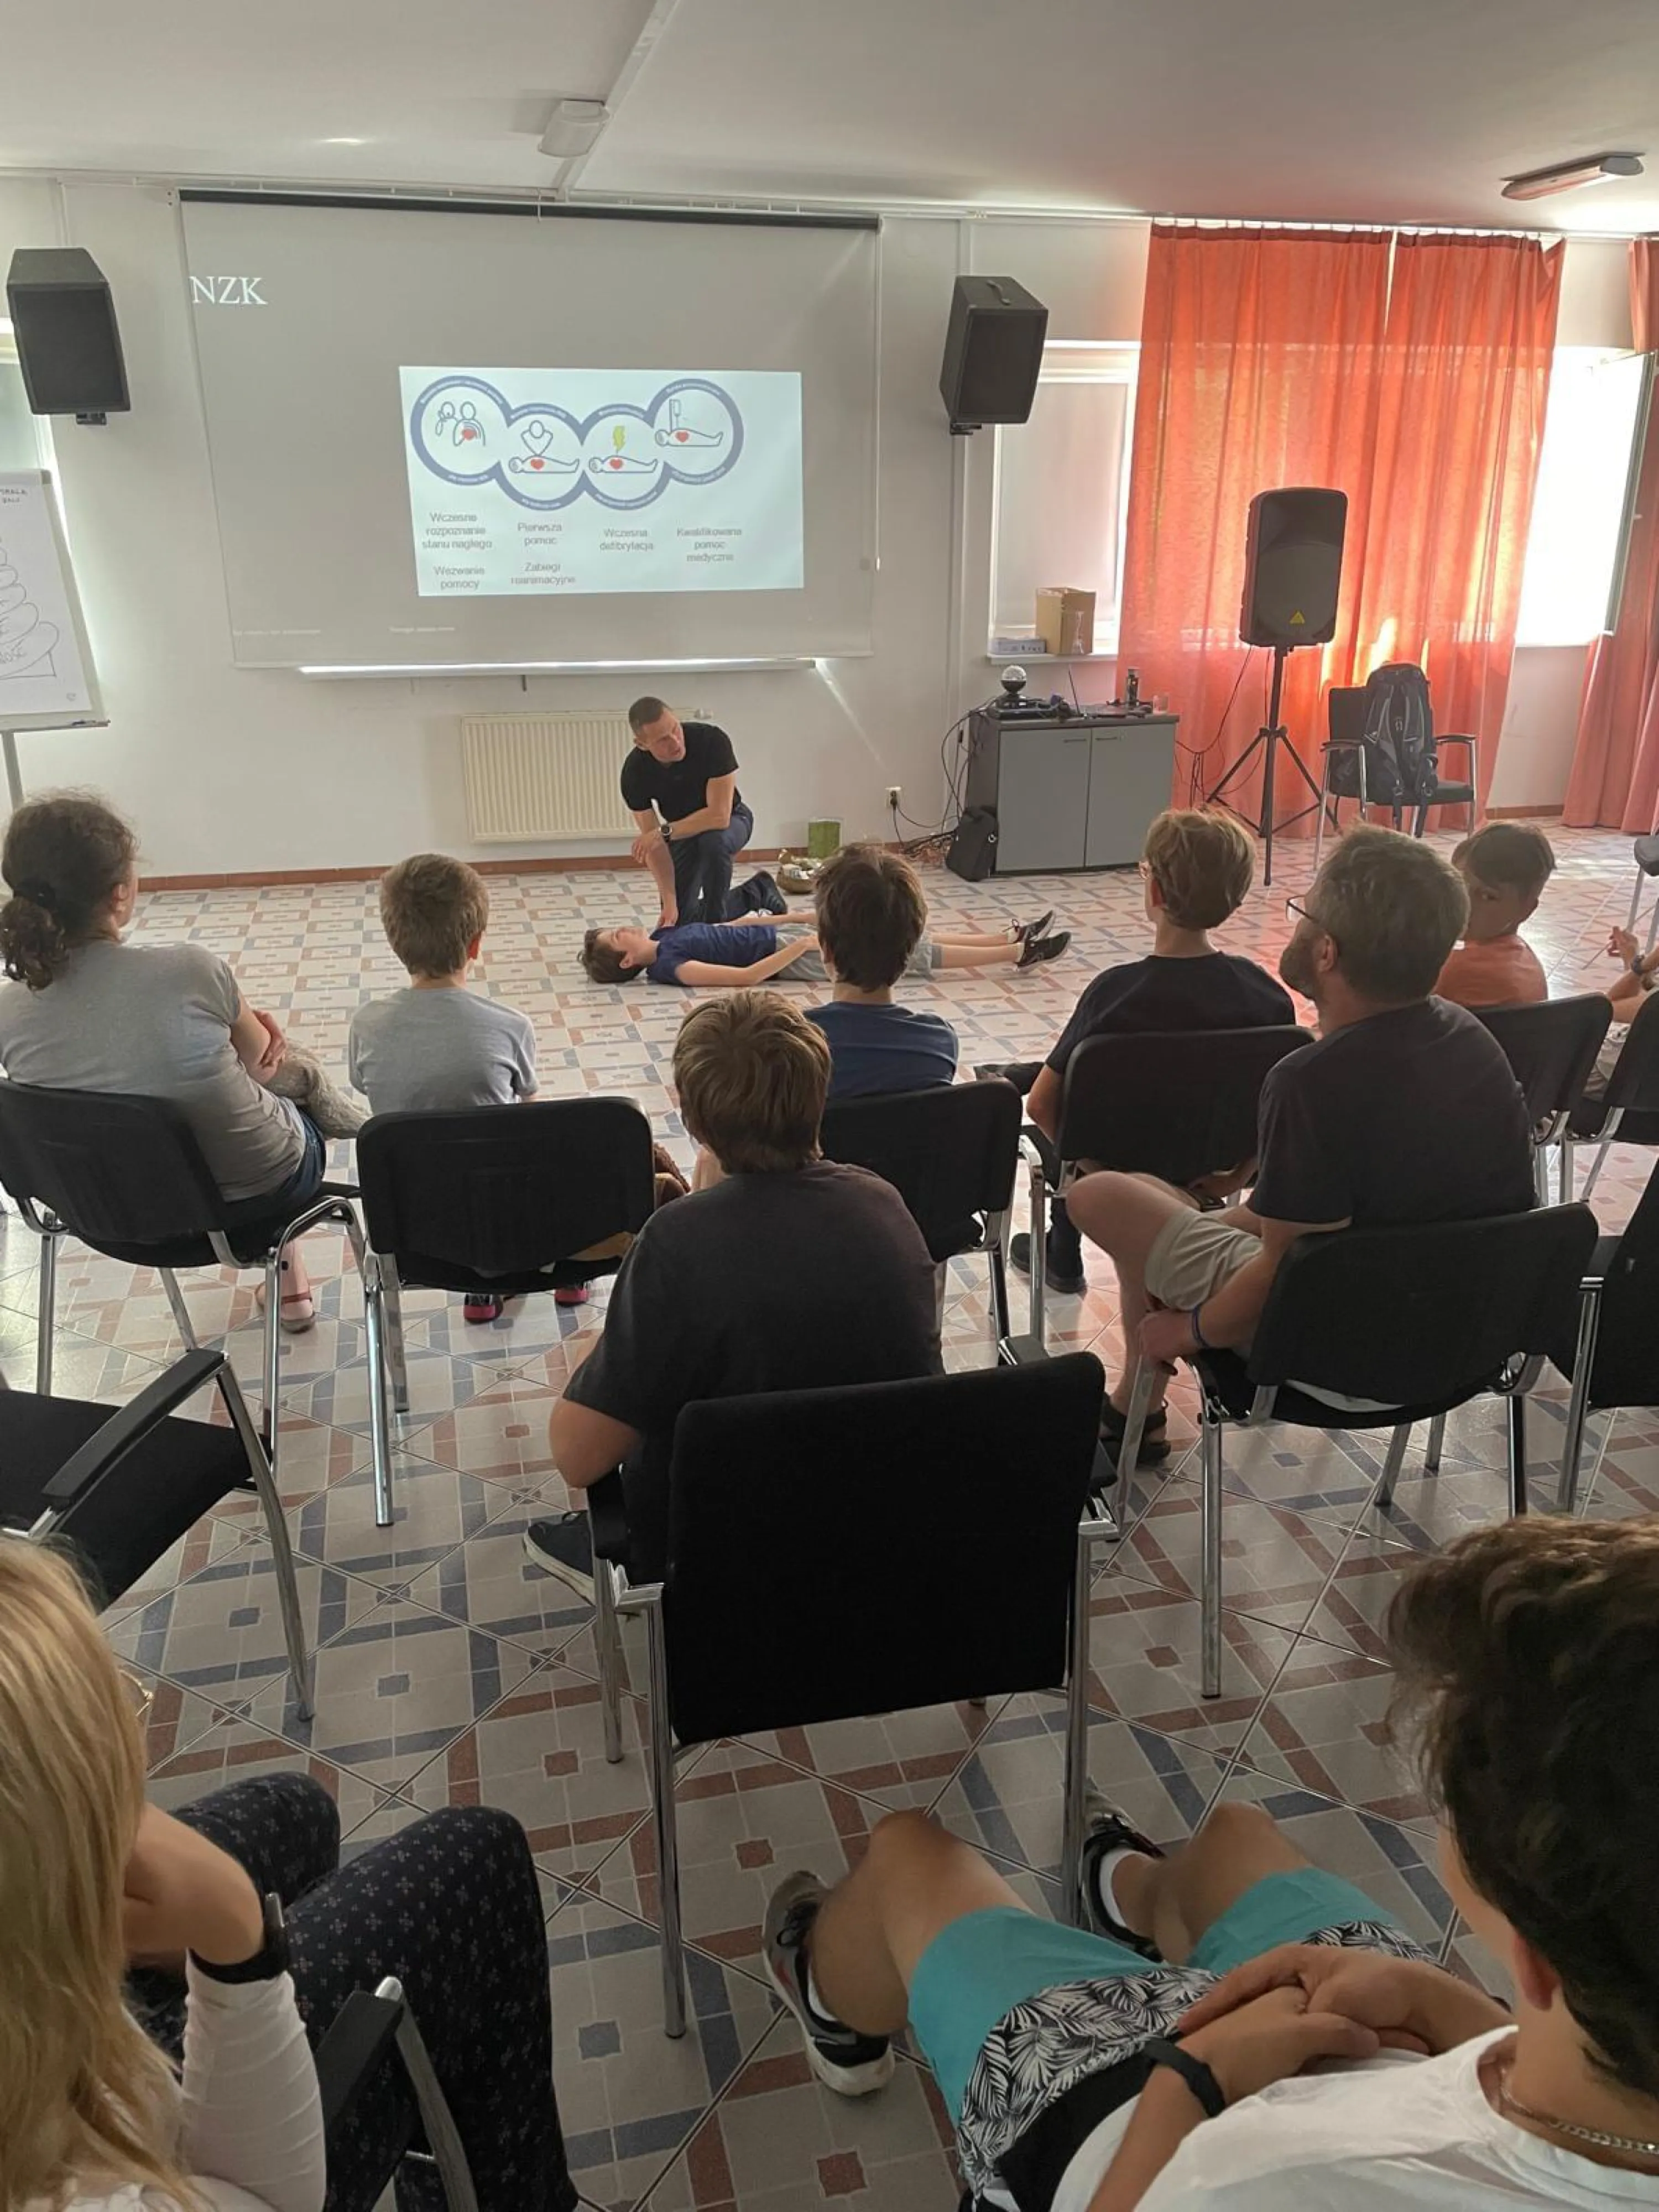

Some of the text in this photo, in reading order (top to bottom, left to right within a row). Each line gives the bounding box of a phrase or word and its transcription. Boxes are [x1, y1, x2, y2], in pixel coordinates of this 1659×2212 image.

[189, 276, 269, 305] NZK
[517, 522, 562, 531] Pierwsza
[425, 528, 486, 536] rozpoznanie
[603, 528, 648, 538] Wczesna
[422, 539, 450, 549] stanu
[524, 537, 557, 546] pomoc
[599, 541, 654, 551] defibrylacja
[694, 541, 726, 549] pomoc
[433, 566, 485, 576] Wezwanie
[525, 562, 560, 572] Zabiegi
[440, 580, 480, 589] pomocy
[511, 576, 576, 585] reanimacyjne
